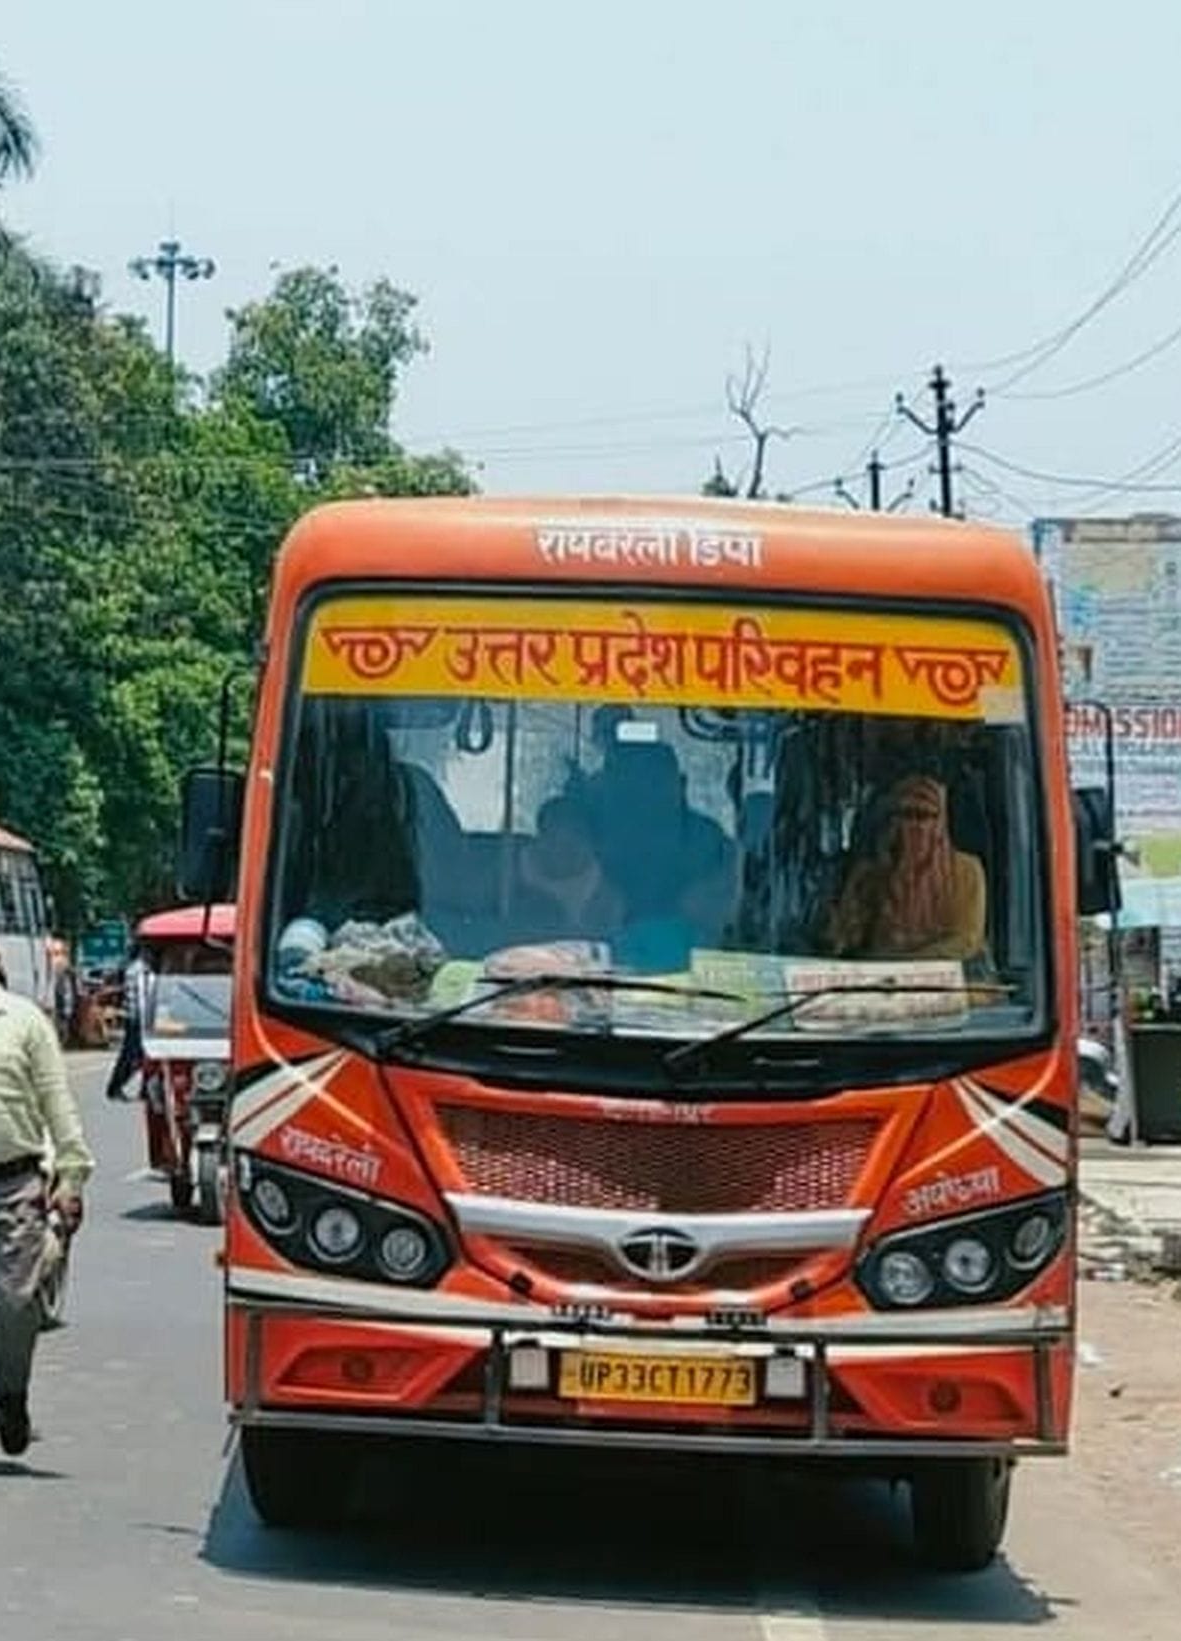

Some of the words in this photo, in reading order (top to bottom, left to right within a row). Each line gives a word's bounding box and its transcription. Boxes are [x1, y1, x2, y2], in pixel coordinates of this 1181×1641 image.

[444, 626, 563, 687] उत्तर
[567, 610, 685, 697] प्रदेश
[692, 616, 887, 705] परिवहन
[579, 1359, 752, 1397] UP33CT1773
